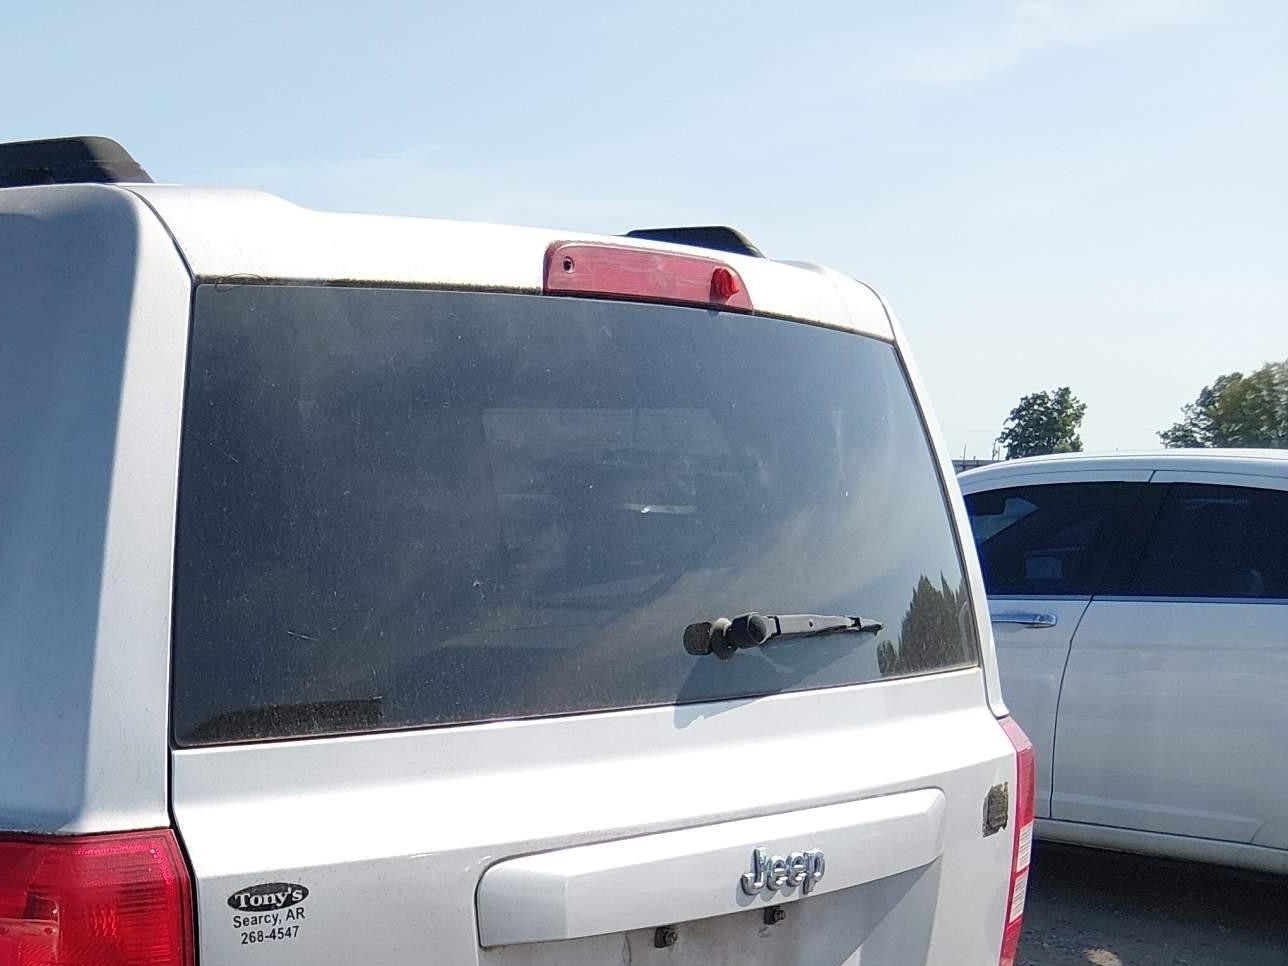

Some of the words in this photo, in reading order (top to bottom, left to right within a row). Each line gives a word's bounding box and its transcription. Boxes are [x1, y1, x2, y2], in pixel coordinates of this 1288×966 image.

[740, 847, 826, 896] Jeep
[234, 886, 303, 909] Tony's
[233, 912, 282, 929] Searcy,
[285, 906, 306, 921] AR
[240, 925, 300, 945] 268-4547
